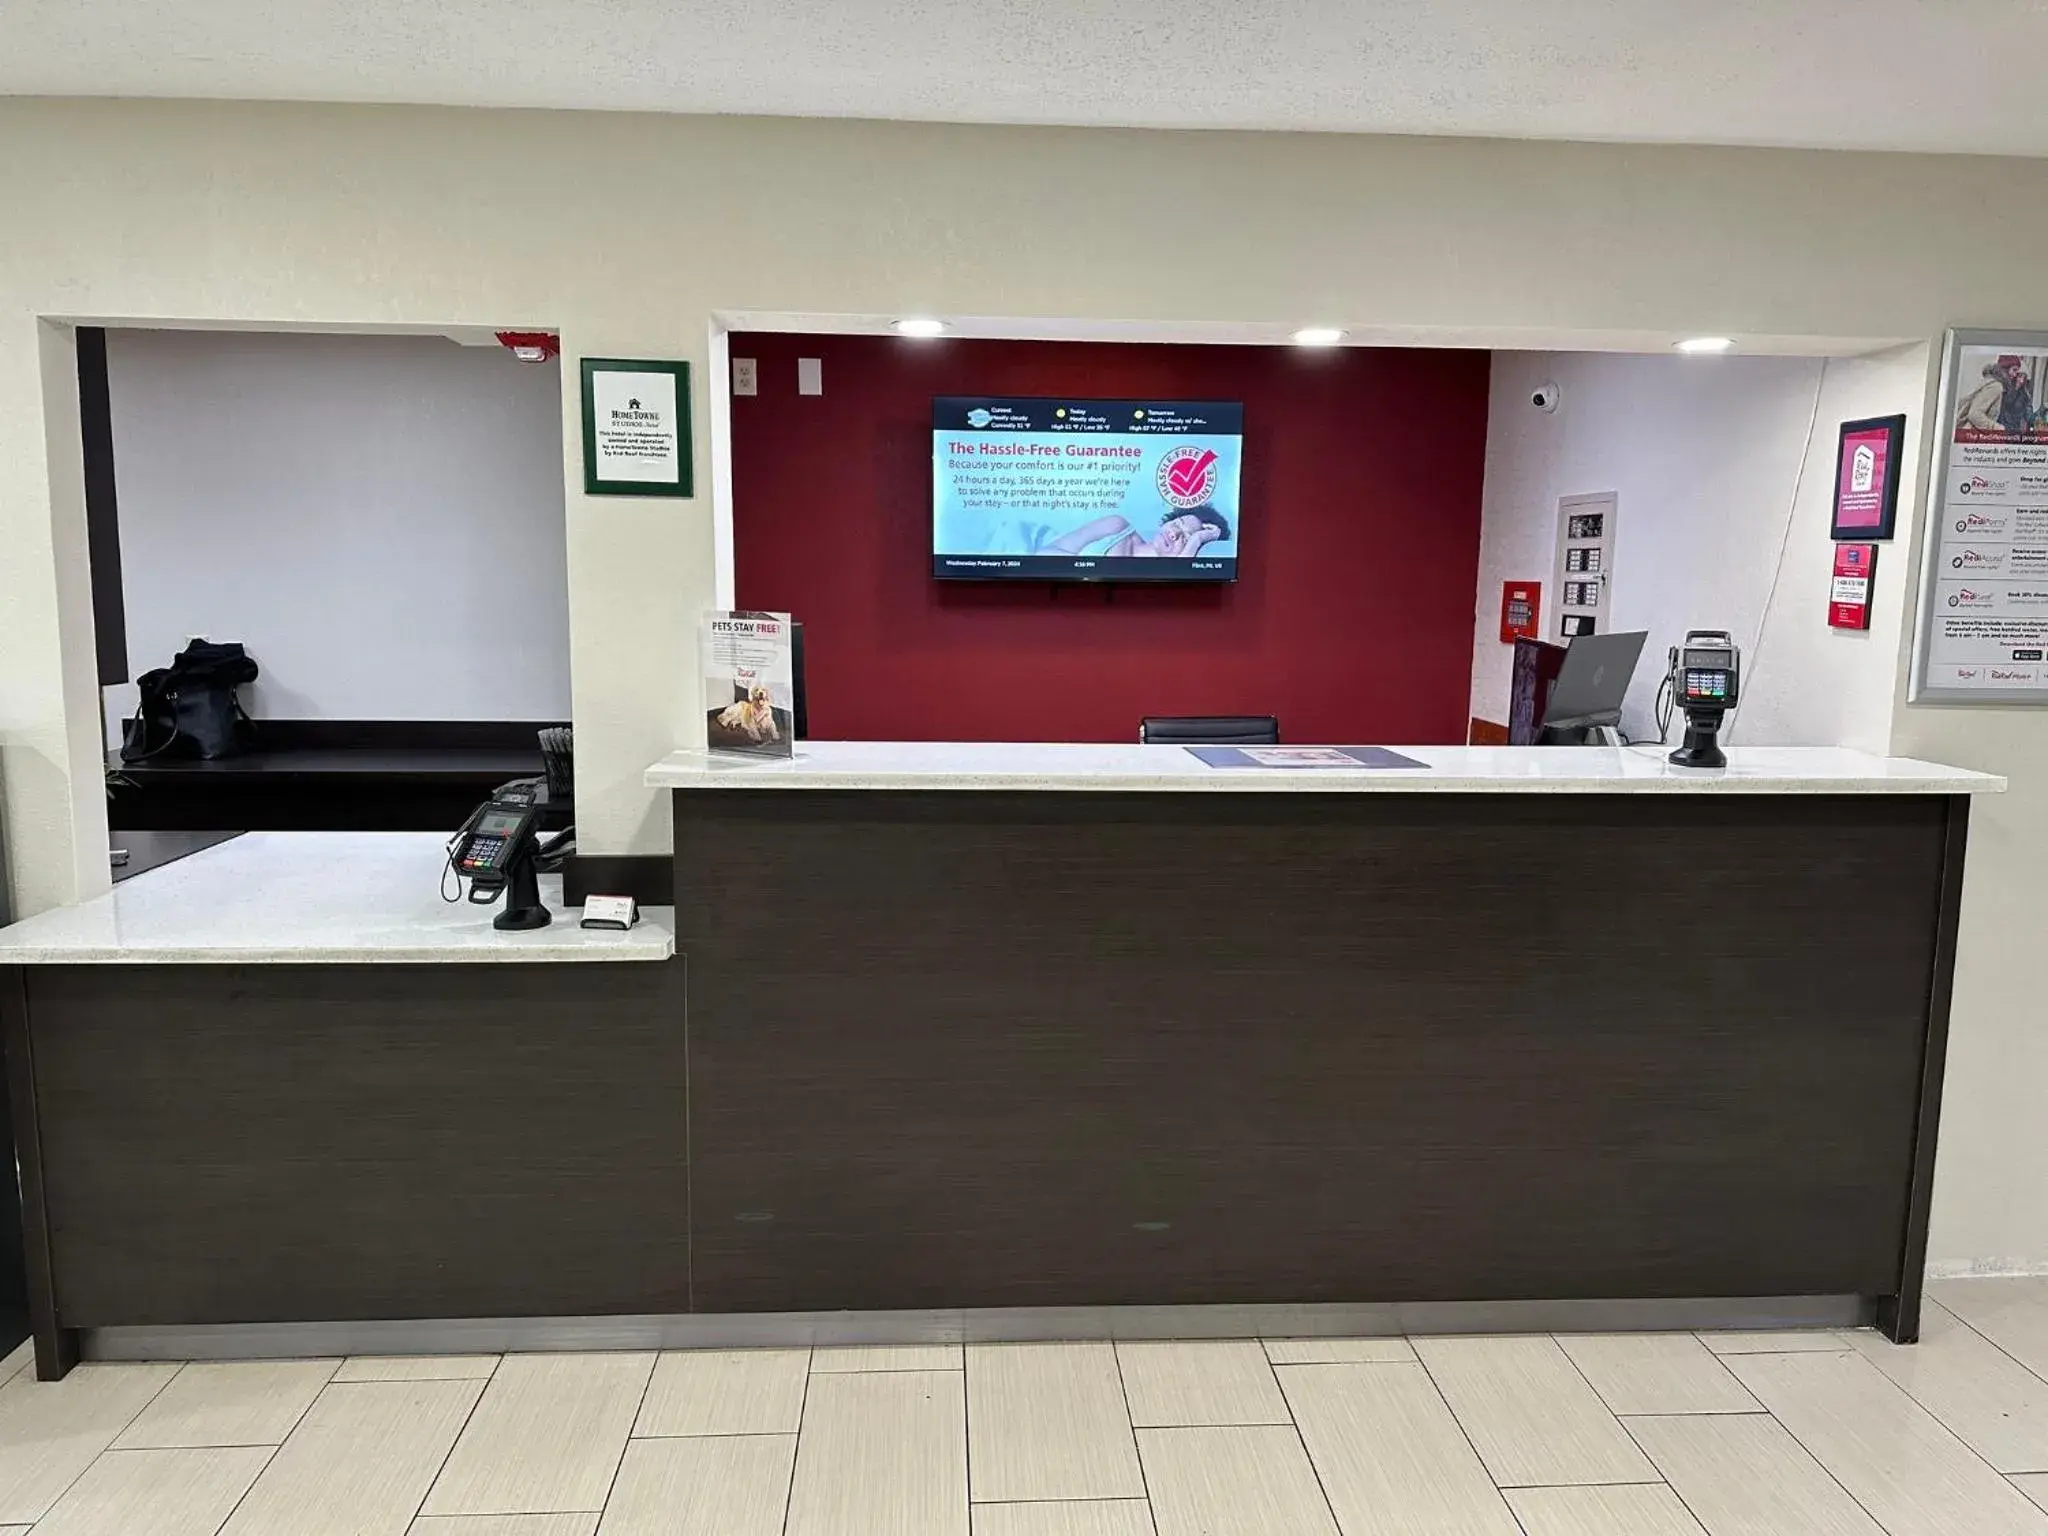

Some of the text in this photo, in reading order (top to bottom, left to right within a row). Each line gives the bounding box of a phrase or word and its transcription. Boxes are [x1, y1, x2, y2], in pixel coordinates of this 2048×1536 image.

[949, 442, 1142, 457] The Hassle-Free Guarantee
[948, 459, 1141, 473] Because your comfort is our #1 priority!
[953, 475, 964, 484] 24
[966, 475, 990, 484] hours
[1000, 475, 1016, 486] day,
[1019, 476, 1034, 484] 365
[1036, 476, 1055, 486] days
[1064, 478, 1084, 487] year
[1086, 477, 1109, 486] we're
[1111, 477, 1130, 486] here
[969, 487, 991, 495] solve
[993, 489, 1008, 497] any
[1010, 487, 1046, 497] problem
[1049, 488, 1066, 496] that
[1068, 489, 1095, 497] occurs
[1097, 488, 1125, 498] during
[963, 500, 982, 508] your
[984, 500, 1001, 508] stay
[1022, 500, 1040, 508] that
[1042, 500, 1070, 509] night's
[1072, 502, 1088, 510] stay
[1092, 501, 1098, 509] is
[1099, 501, 1119, 509] free.
[712, 622, 780, 634] PETS STAY FREE!
